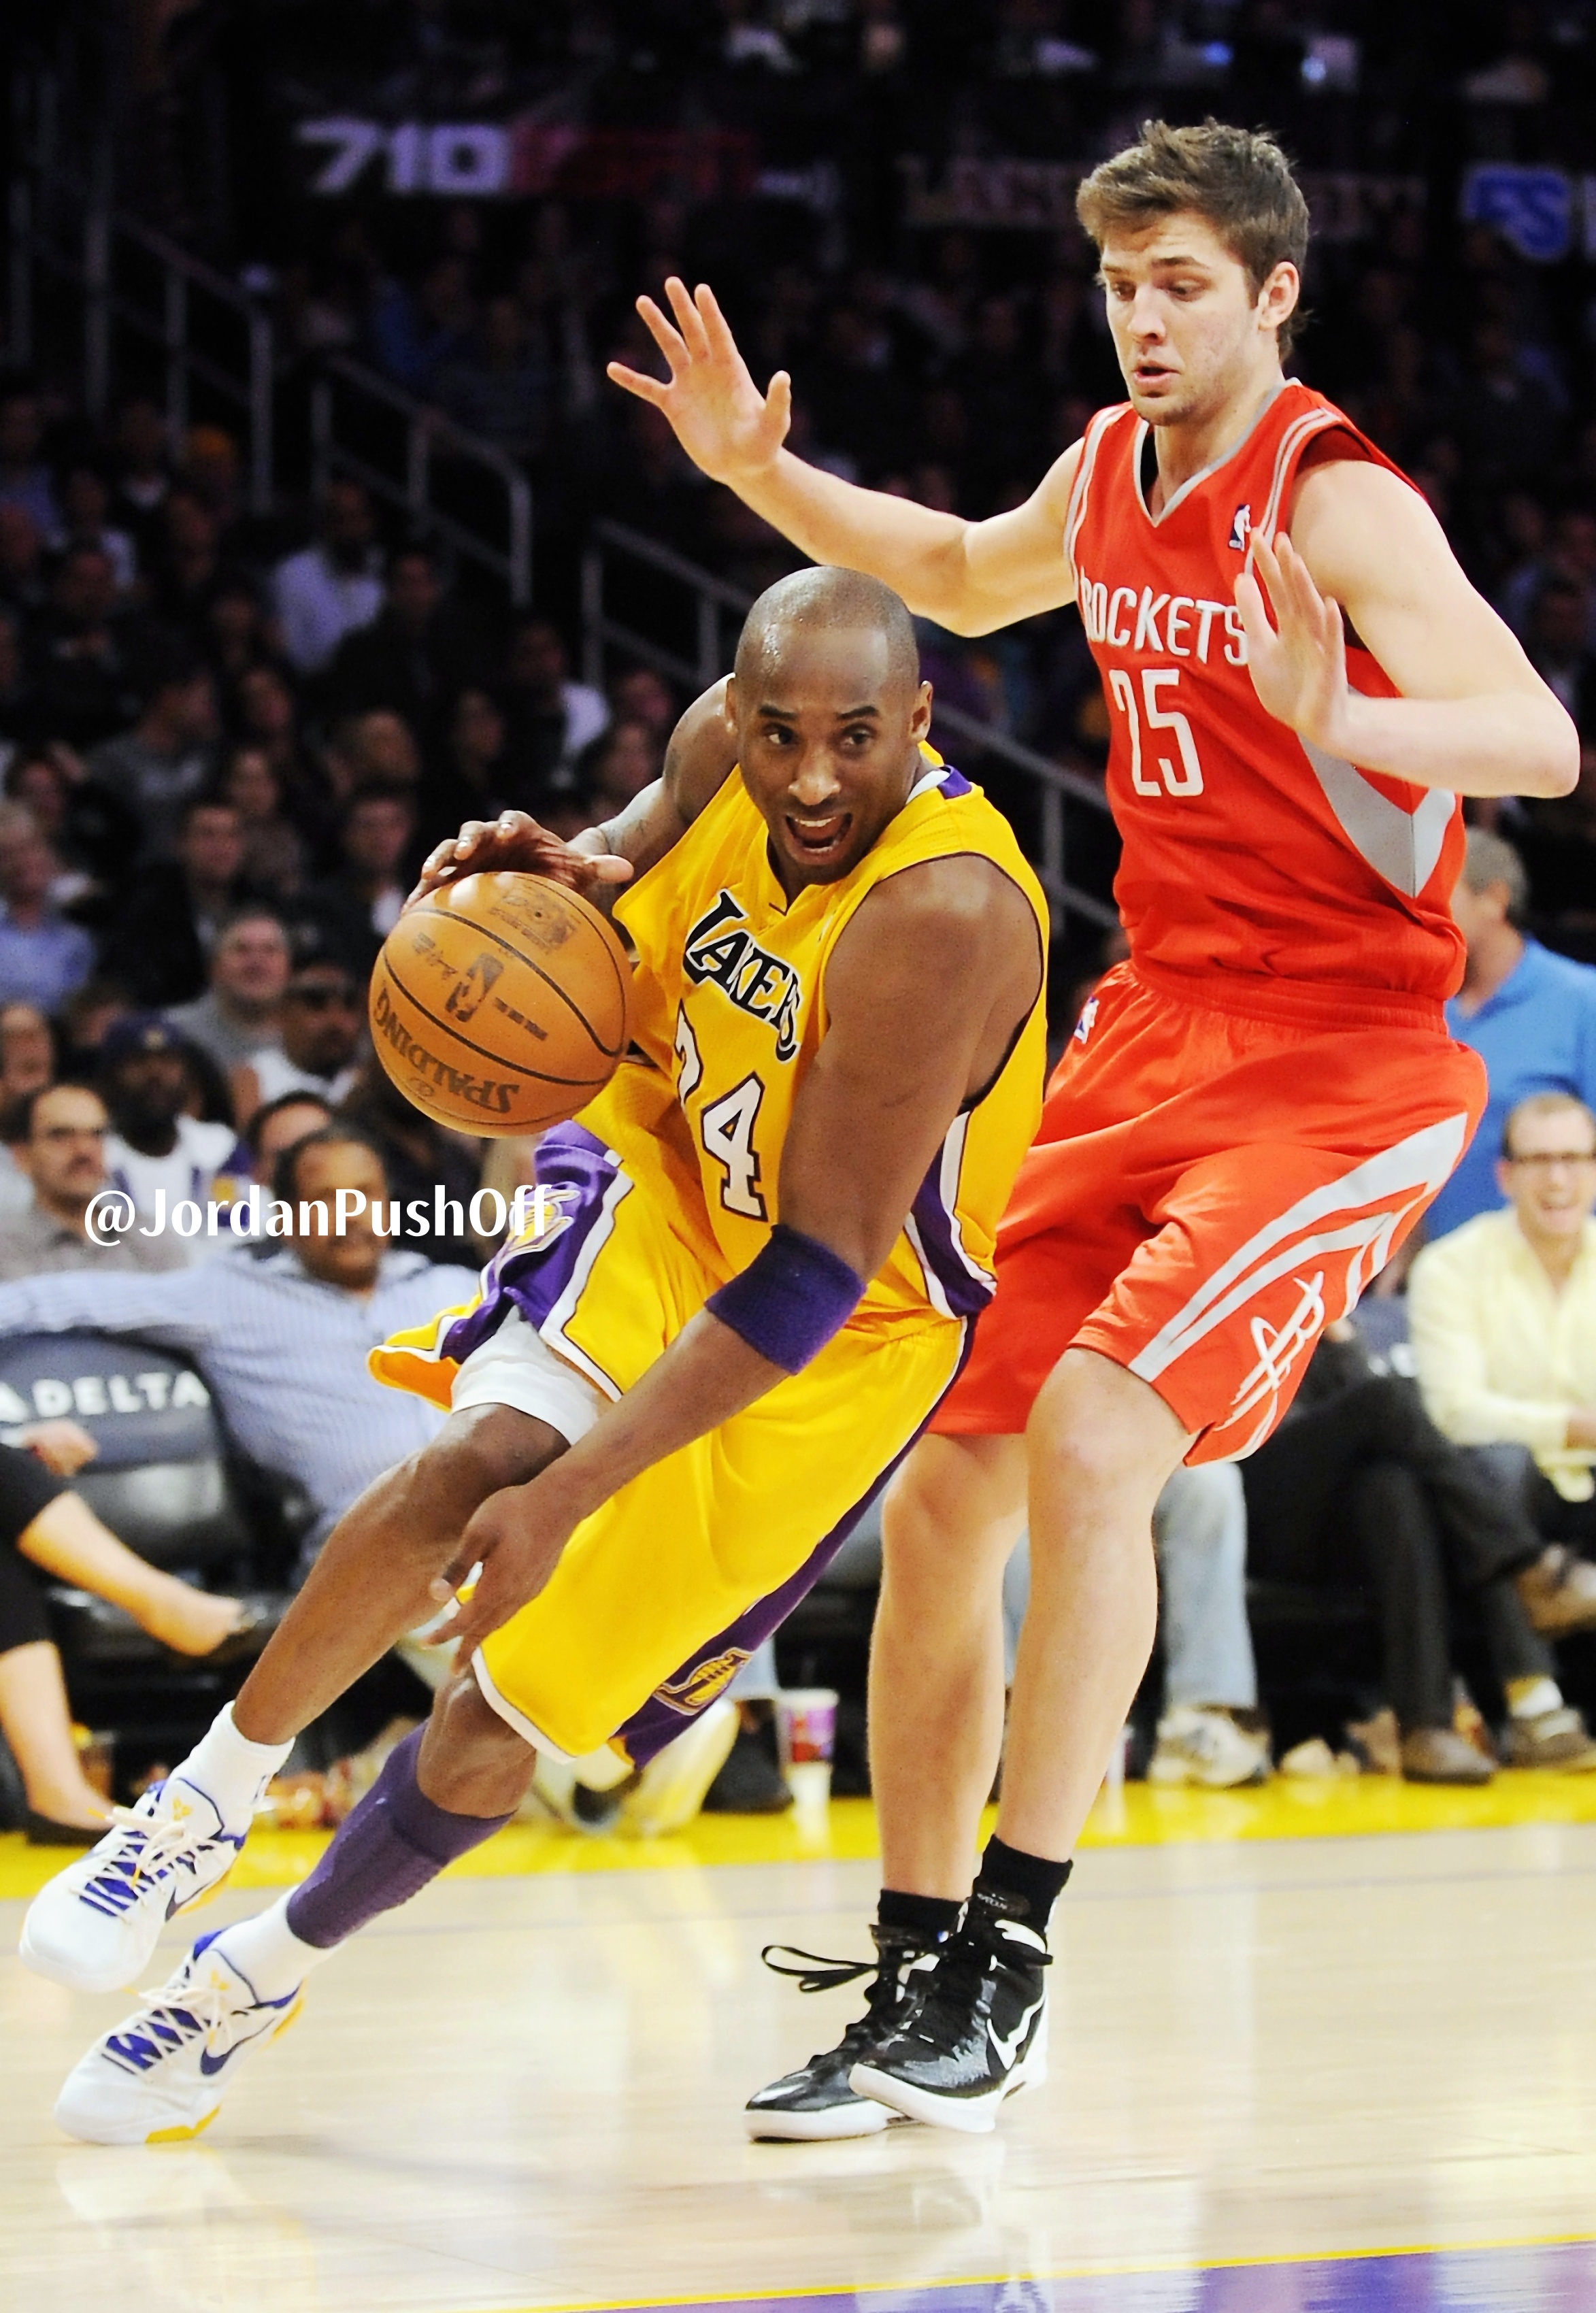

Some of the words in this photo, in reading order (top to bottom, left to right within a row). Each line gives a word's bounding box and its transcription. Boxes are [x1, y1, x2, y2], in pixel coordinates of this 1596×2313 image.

[298, 120, 512, 196] 710
[1080, 565, 1249, 666] ROCKETS
[1109, 668, 1204, 797] 25
[374, 986, 520, 1114] SPALDING
[33, 1370, 210, 1418] DELTA
